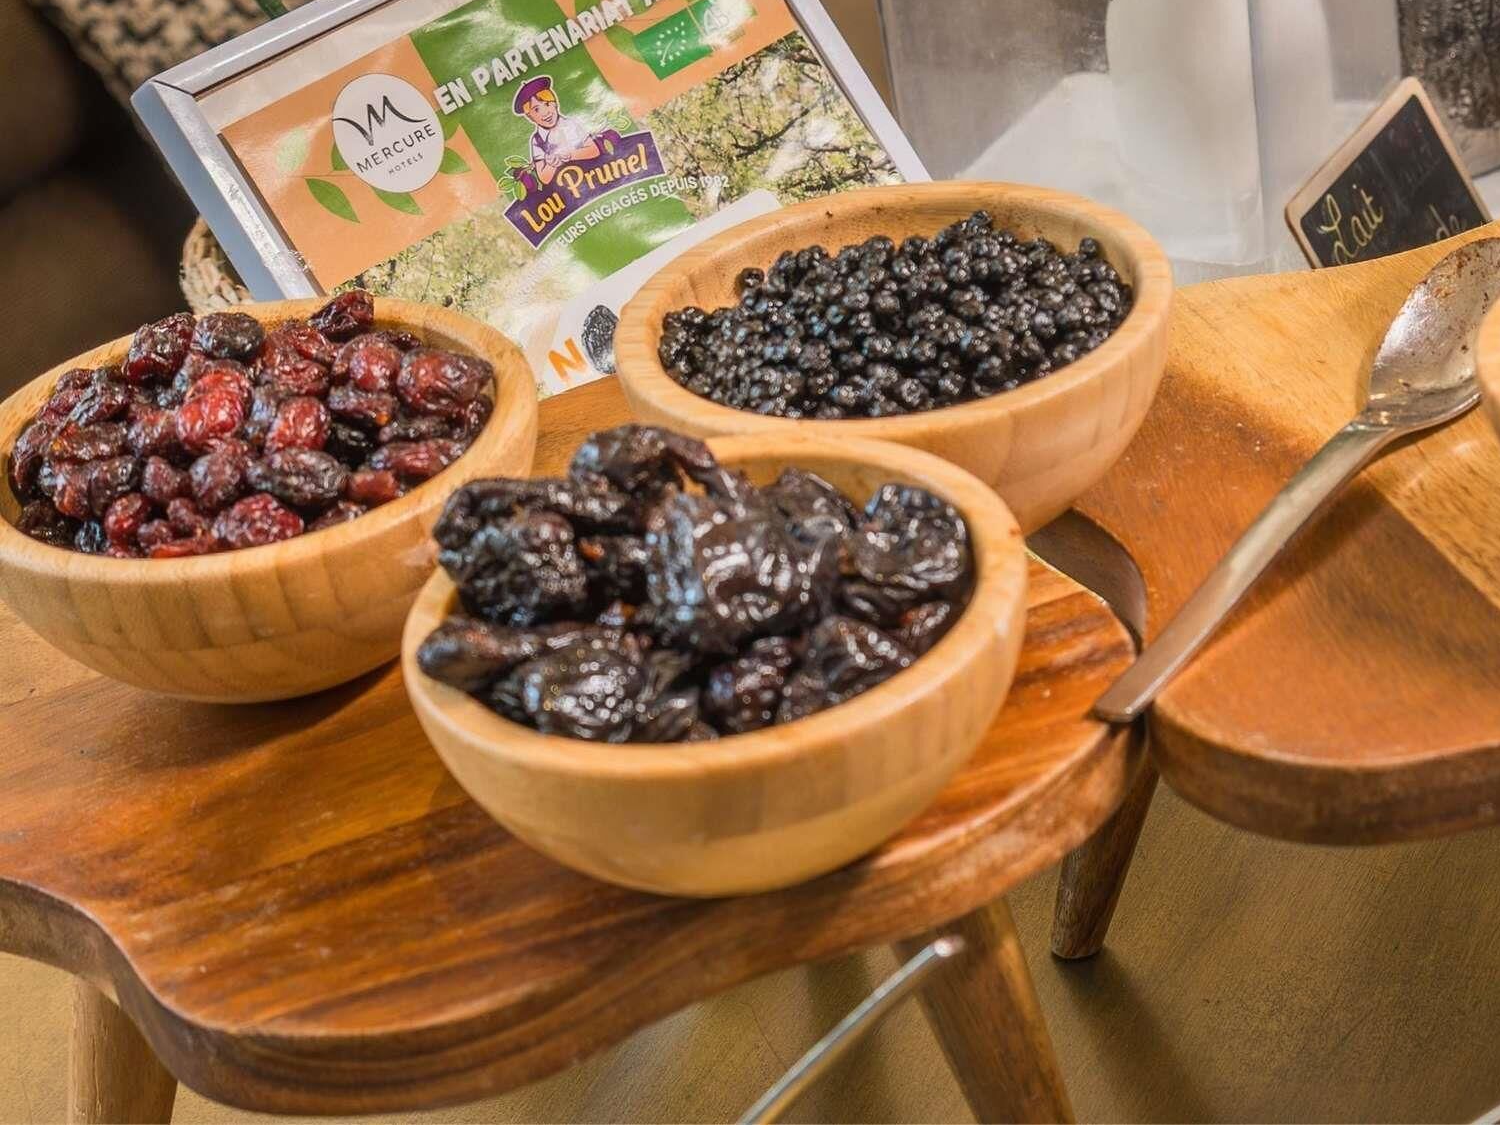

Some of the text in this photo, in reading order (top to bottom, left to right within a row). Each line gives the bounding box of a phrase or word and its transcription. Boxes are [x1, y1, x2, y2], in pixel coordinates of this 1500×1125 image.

[432, 76, 473, 116] EN
[355, 123, 437, 174] MERCURE
[387, 152, 424, 175] HOTELS
[520, 142, 649, 234] Lou Prunel
[584, 186, 649, 228] ENGAGÉS
[649, 176, 699, 198] DEPUIS
[1317, 183, 1385, 266] Lait
